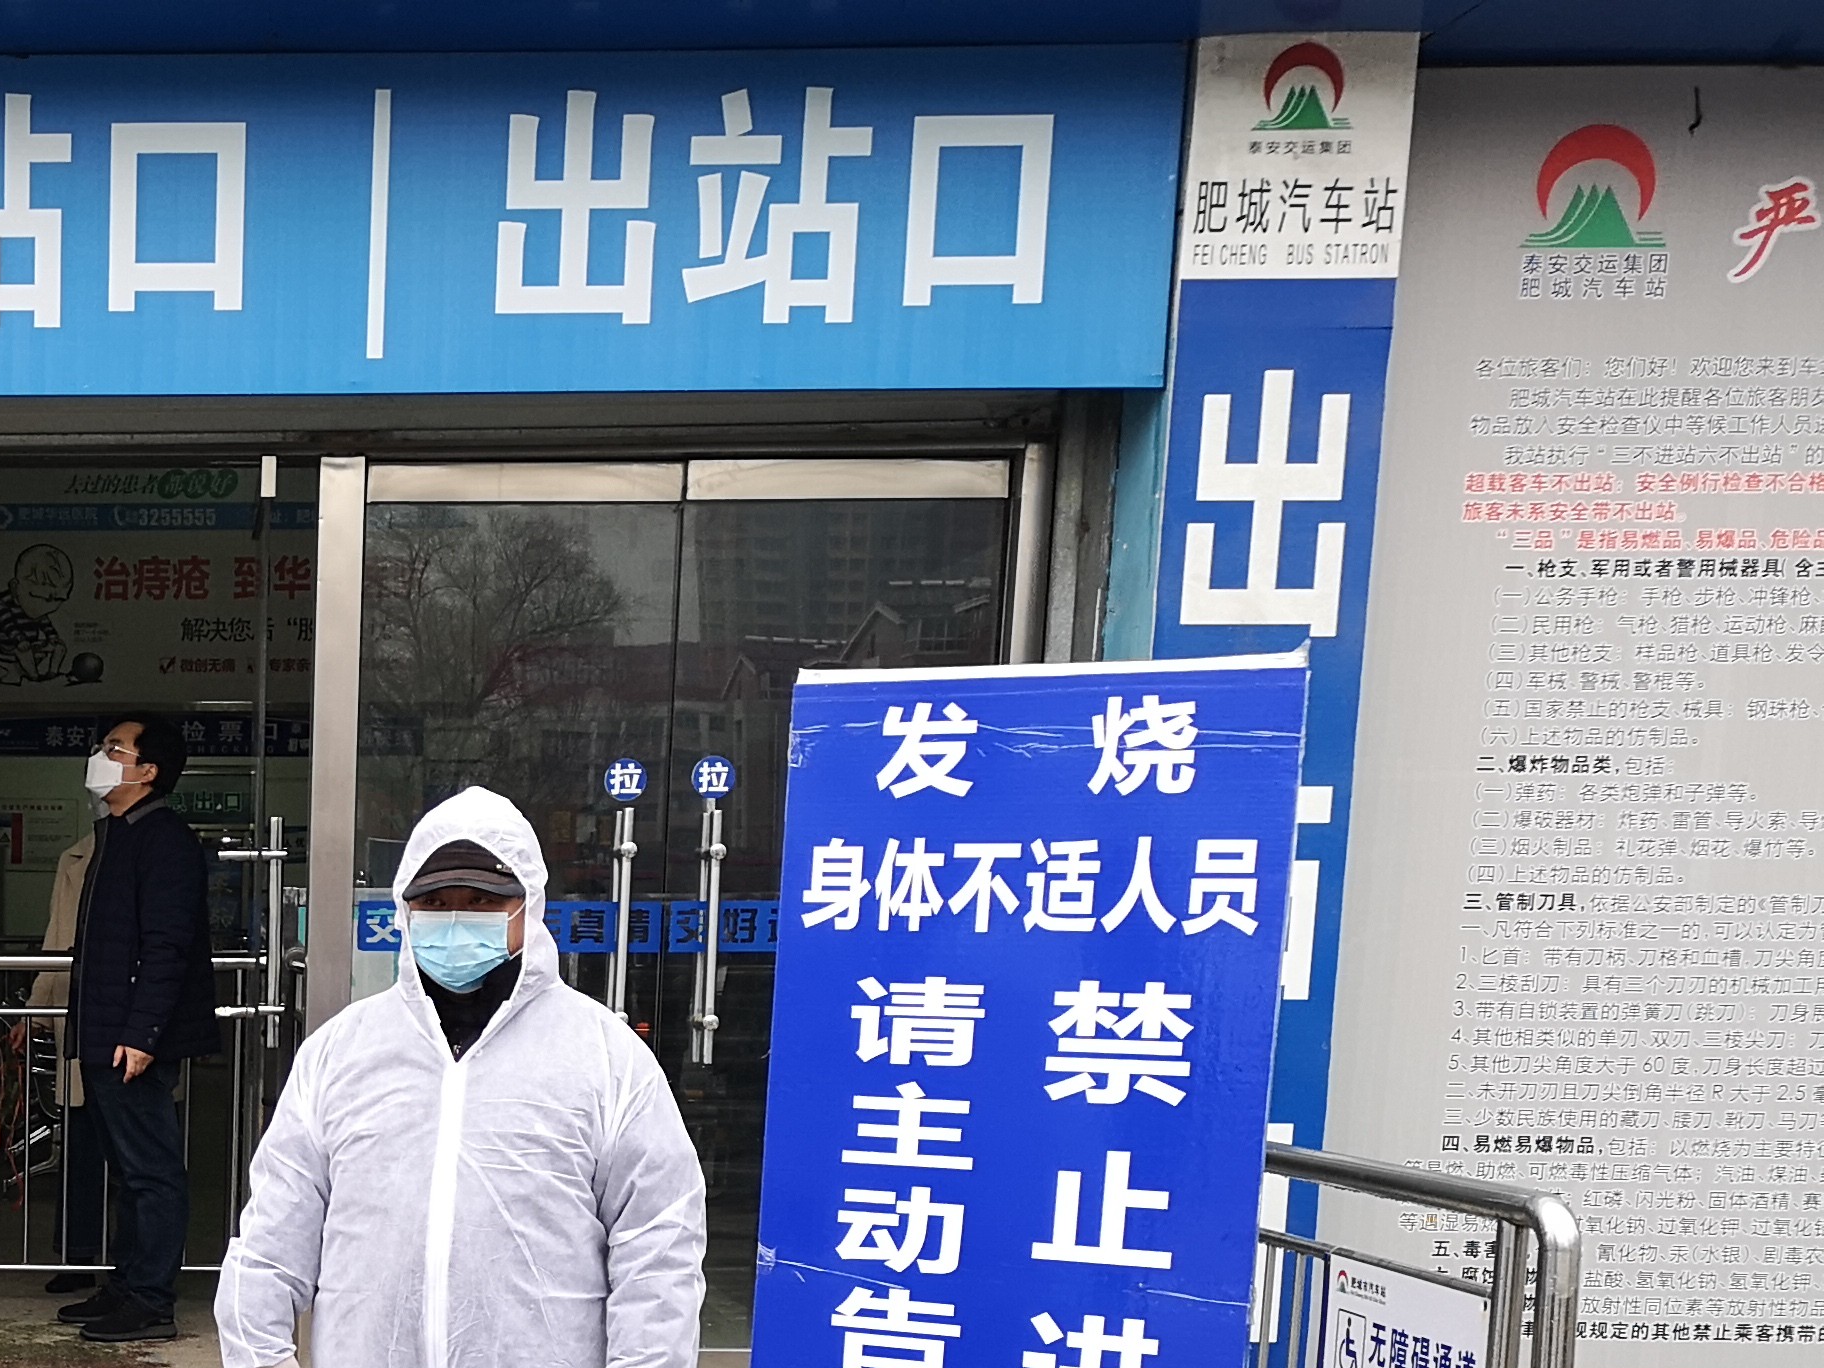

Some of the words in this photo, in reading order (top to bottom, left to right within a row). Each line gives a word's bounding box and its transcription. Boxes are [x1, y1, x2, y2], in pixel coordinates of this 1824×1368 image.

[1249, 140, 1352, 155] 泰安交运集团
[494, 88, 1055, 325] 出站口
[1193, 177, 1398, 235] 肥城汽车站
[1730, 178, 1820, 281] 严
[1286, 243, 1314, 266] BUS
[1522, 253, 1669, 276] 泰安交运集团
[1519, 278, 1667, 299] 肥城汽车站
[1475, 356, 1824, 379] 各位旅客们：您们好！欢迎您来到车
[139, 508, 217, 528] 3255555
[93, 555, 211, 602] 治痔疮
[1490, 614, 1824, 637] （二）民用枪：气枪、猎枪、运动枪、麻
[1482, 698, 1824, 721] （五）国家禁止的枪支、械具：钢珠枪、
[608, 761, 644, 798] 拉
[696, 759, 732, 795] 拉
[1472, 810, 1824, 833] （二）爆破器材：炸药、雷管、导火索、导
[800, 833, 1261, 938] 身体不适人员
[1461, 920, 1824, 943] 一、凡符合下列标准之一的，可以认定为
[1442, 1108, 1824, 1131] 三、少数民族使用的藏刀、腰刀、靴刀、马刀
